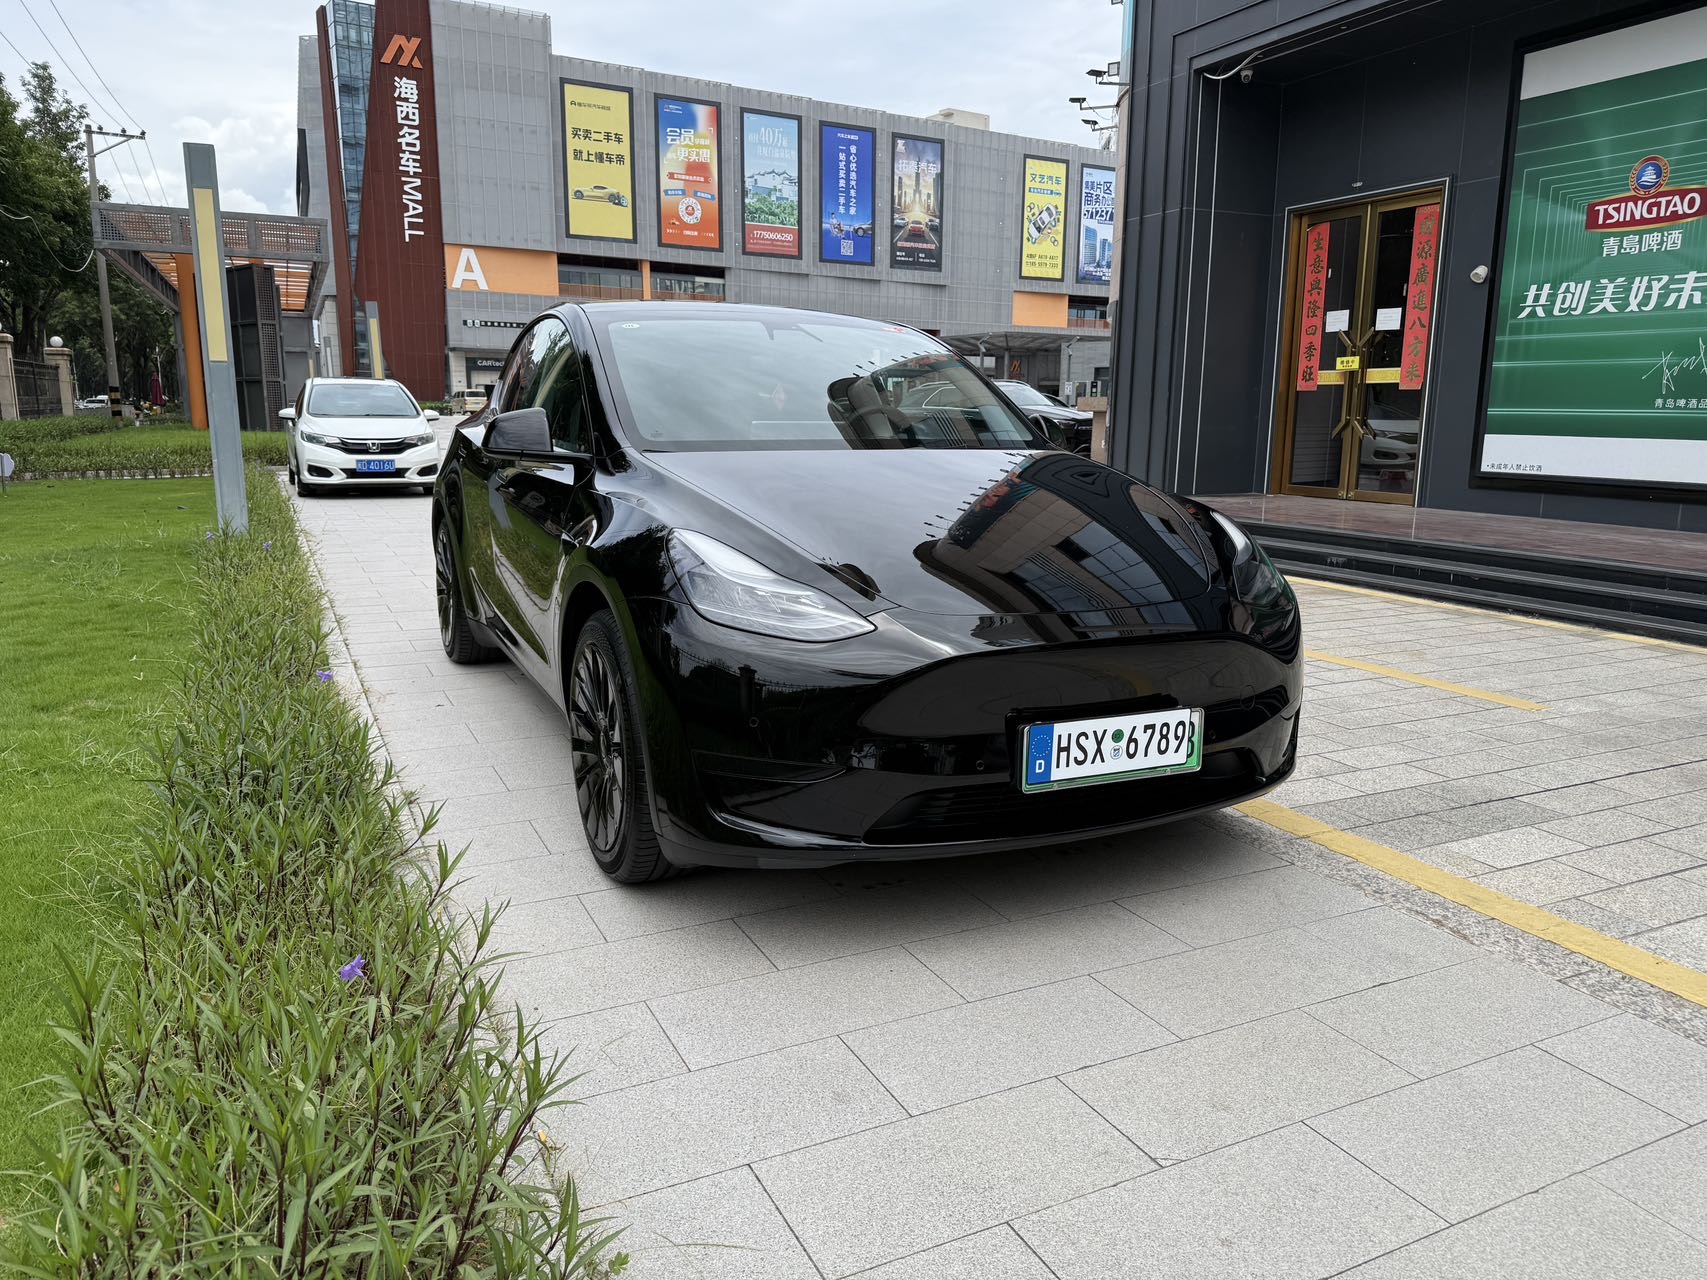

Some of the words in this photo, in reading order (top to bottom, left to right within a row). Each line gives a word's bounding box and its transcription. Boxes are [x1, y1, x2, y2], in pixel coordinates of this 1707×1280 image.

[571, 127, 624, 144] 买卖二手车
[573, 149, 626, 166] 就上懂车帝
[838, 145, 847, 214] 一站式买卖二手车
[849, 144, 858, 215] 省心优选汽车之家
[1030, 173, 1062, 185] 文艺汽车
[1594, 192, 1701, 225] TSINGTAO
[753, 230, 794, 242] 17750606250
[451, 248, 489, 290] A
[1035, 760, 1045, 773] D
[1056, 729, 1108, 769] HSX
[1125, 720, 1187, 760] 6789
